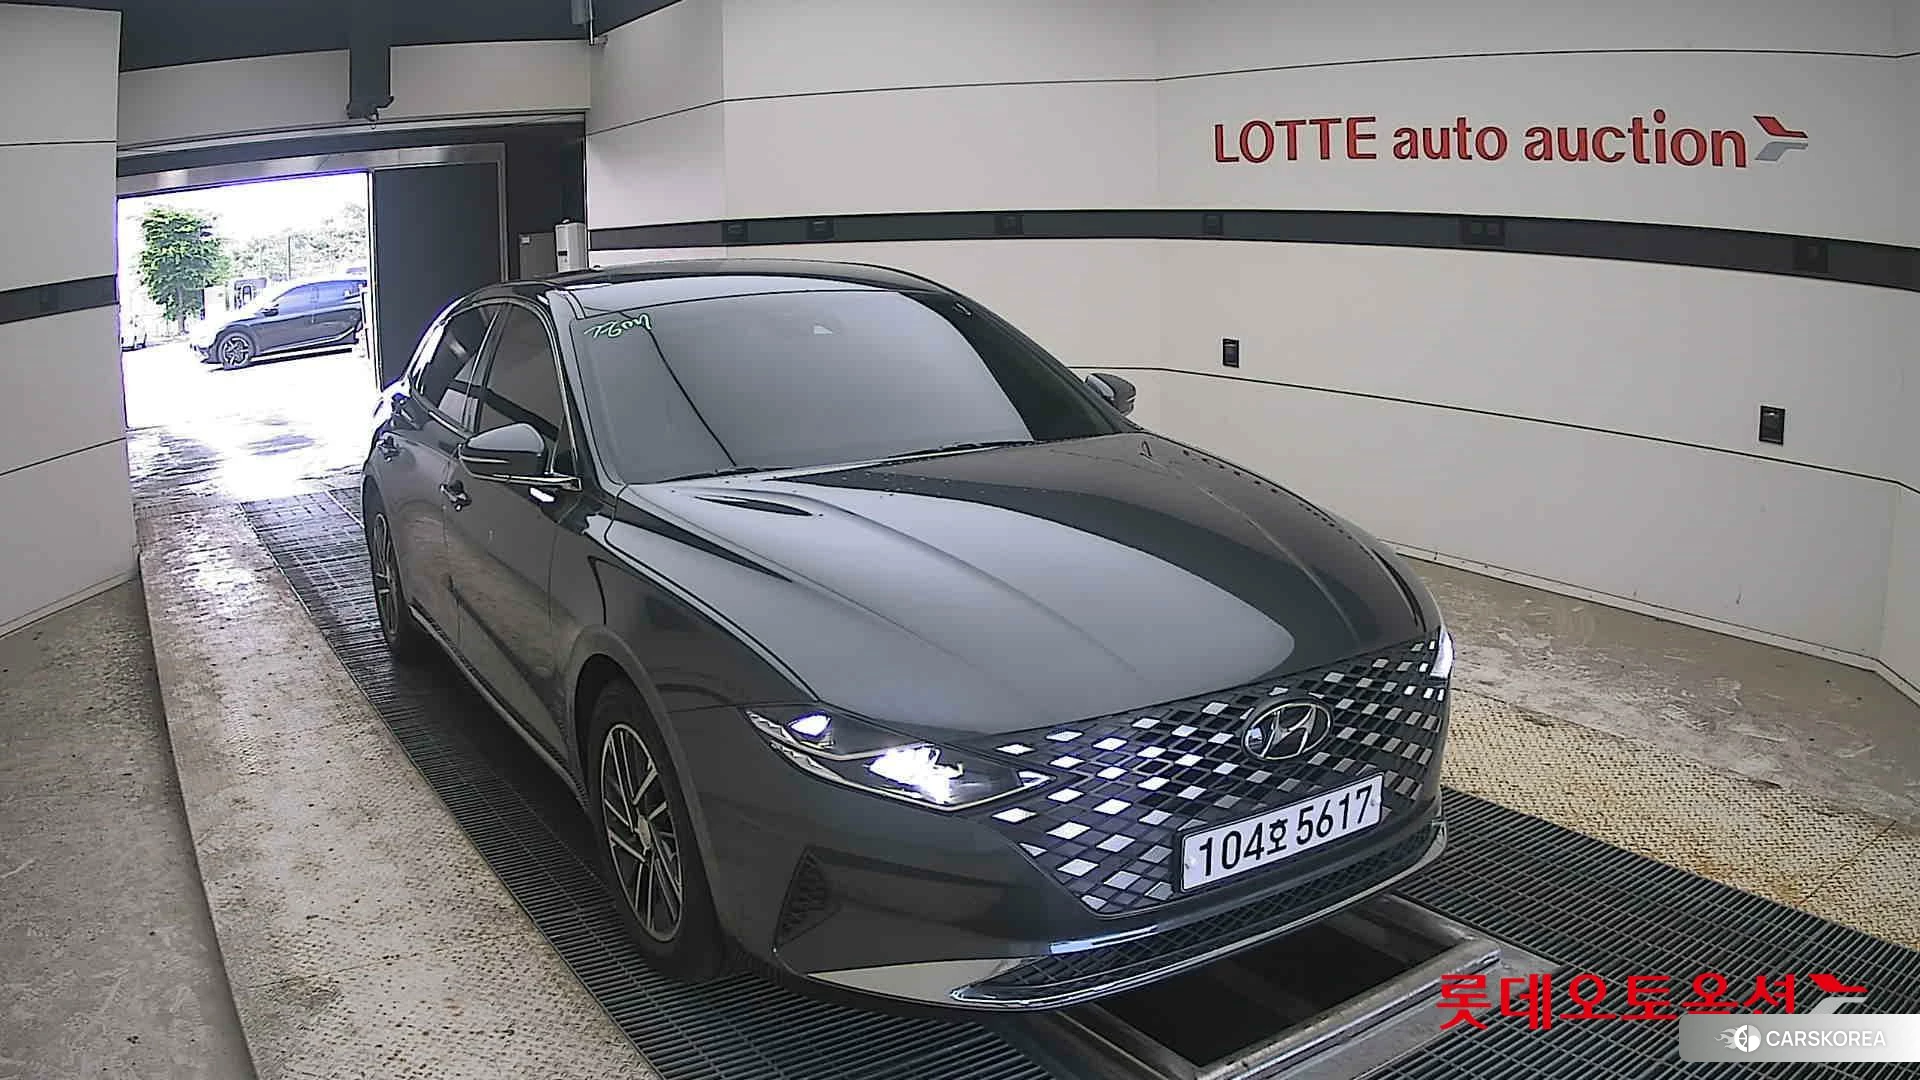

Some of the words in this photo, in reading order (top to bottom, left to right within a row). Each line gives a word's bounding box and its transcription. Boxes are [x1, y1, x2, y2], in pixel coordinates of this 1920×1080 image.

[1214, 116, 1377, 163] LOTTE
[1393, 117, 1508, 161] auto
[1524, 109, 1747, 168] auction
[1296, 784, 1373, 846] 5617
